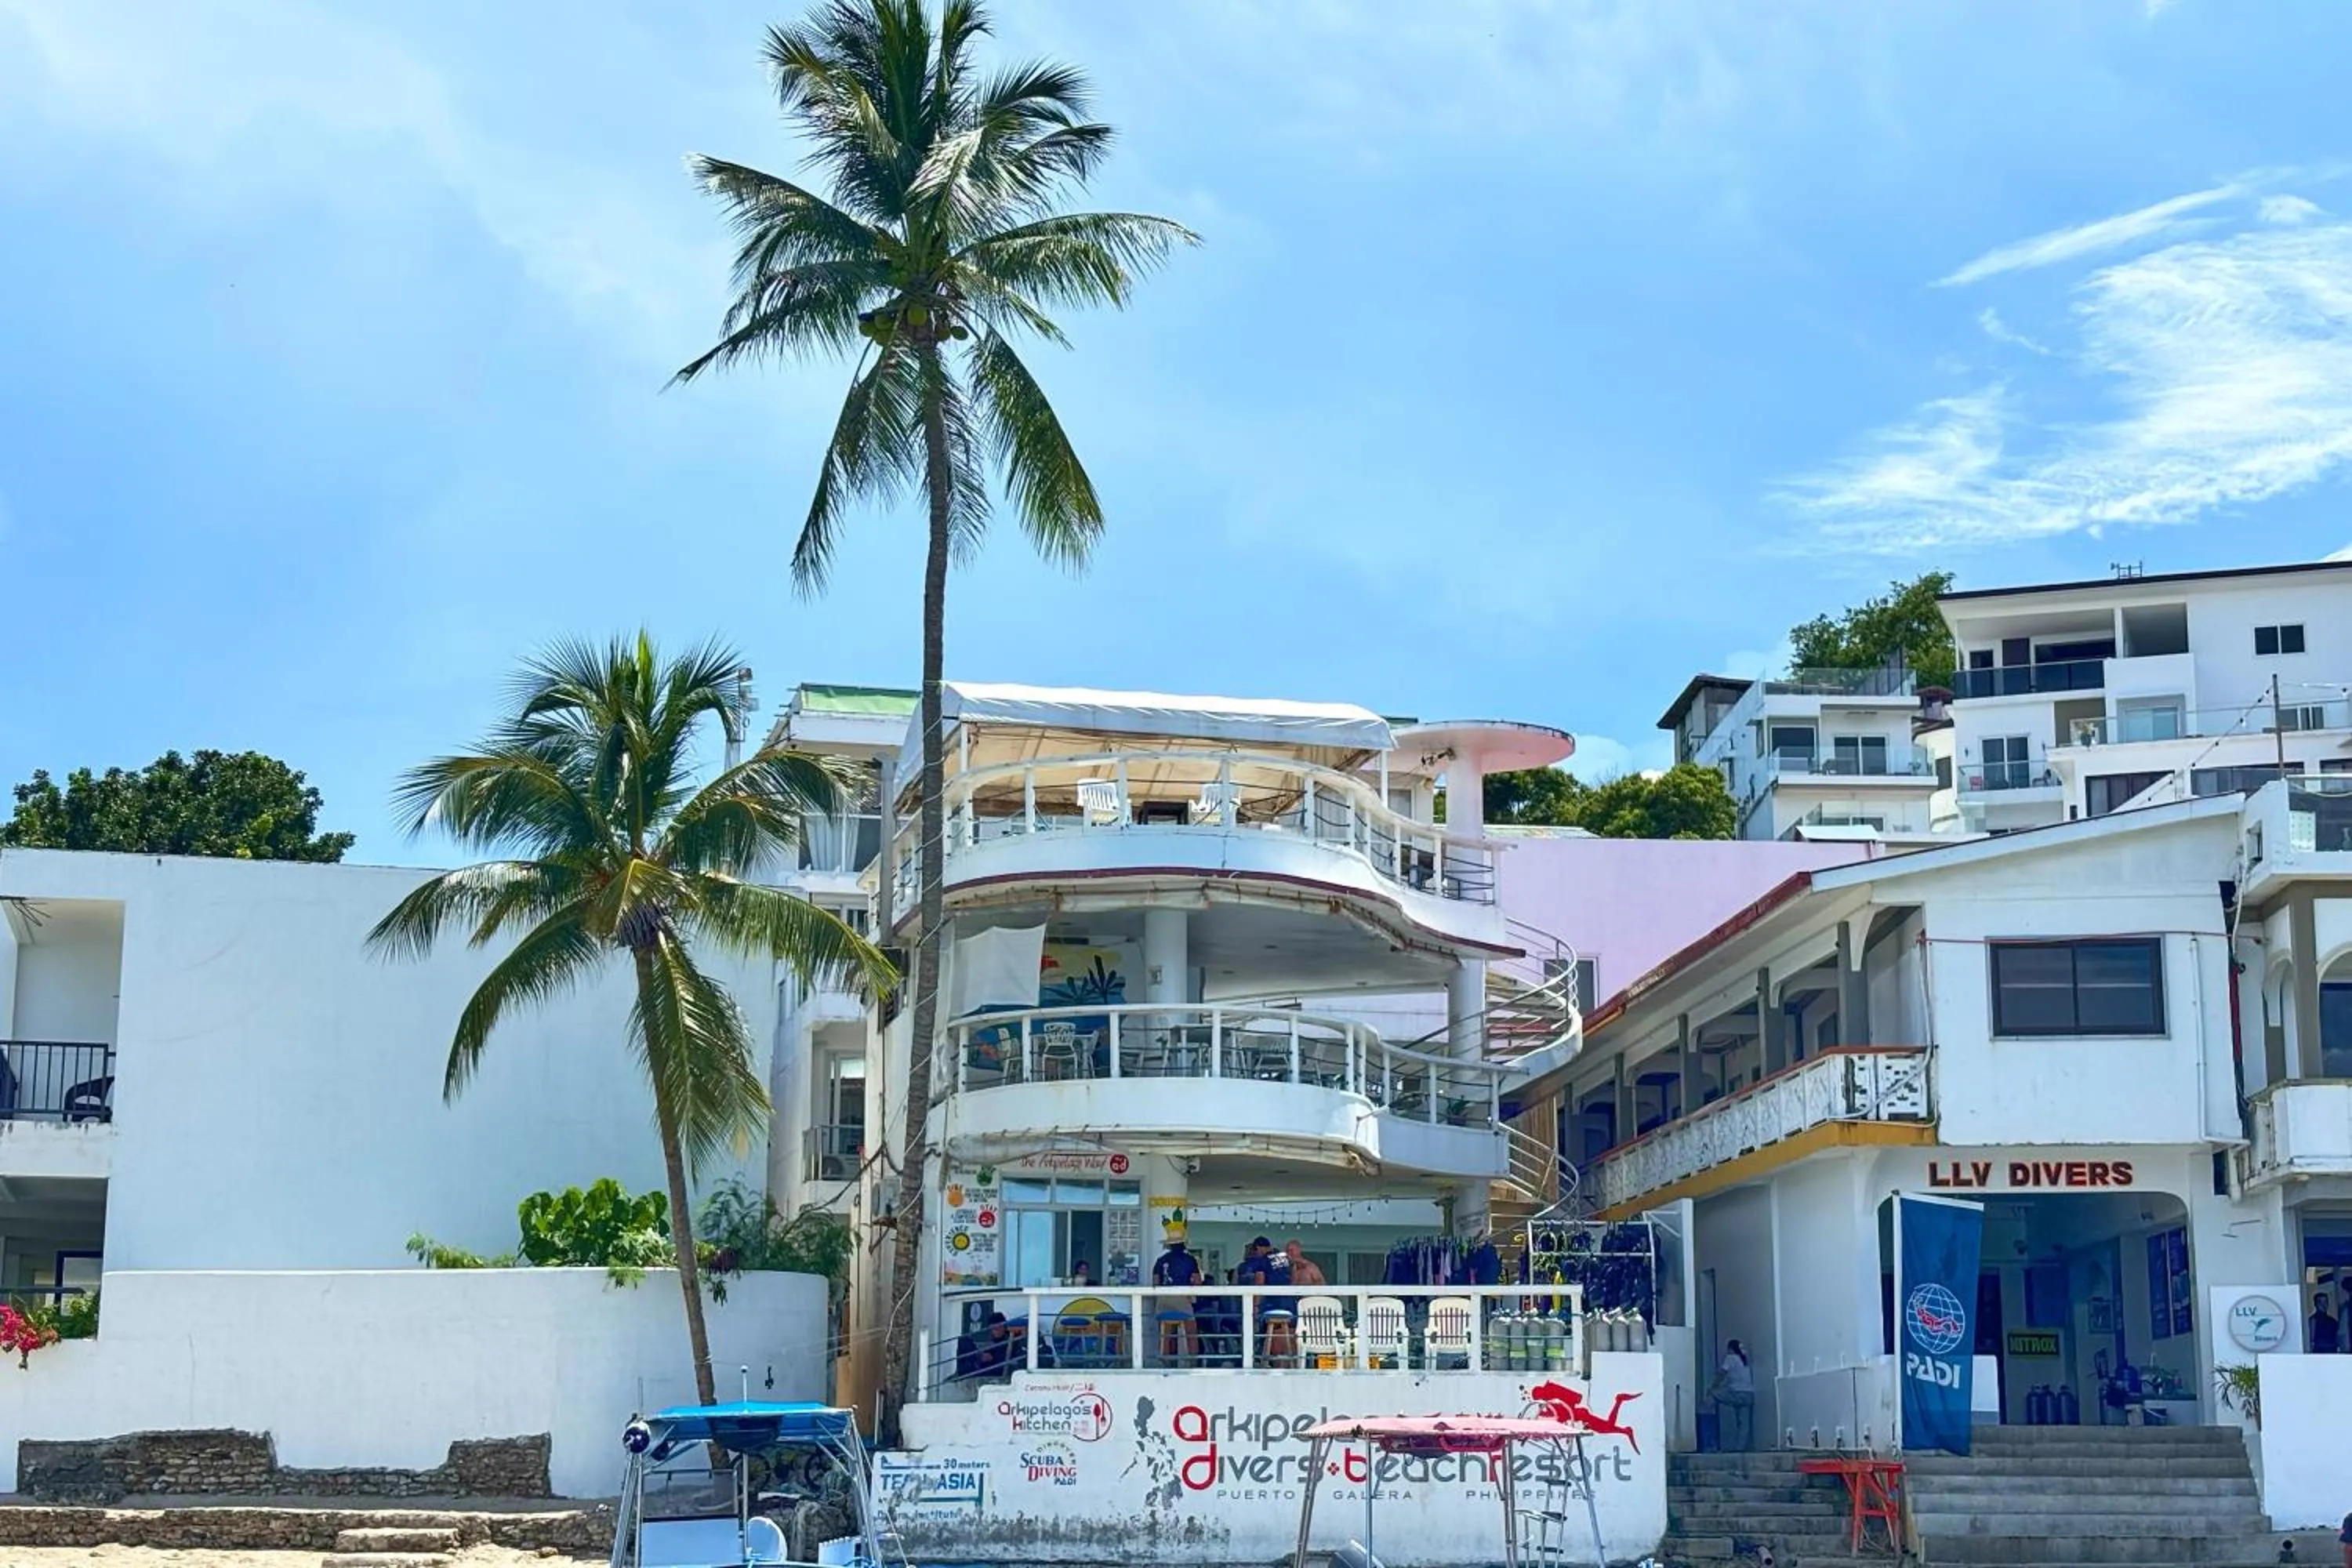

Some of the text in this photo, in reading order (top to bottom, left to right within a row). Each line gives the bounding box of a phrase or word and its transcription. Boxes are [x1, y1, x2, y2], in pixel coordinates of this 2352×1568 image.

[1928, 1162, 2132, 1187] LLV DIVERS
[2235, 1305, 2257, 1316] LLV
[1906, 1352, 1961, 1389] PADI
[1012, 1415, 1072, 1431] kitchen
[943, 1458, 958, 1469] 30
[1218, 1490, 1296, 1500] PUERTO
[1334, 1490, 1412, 1500] GALERA
